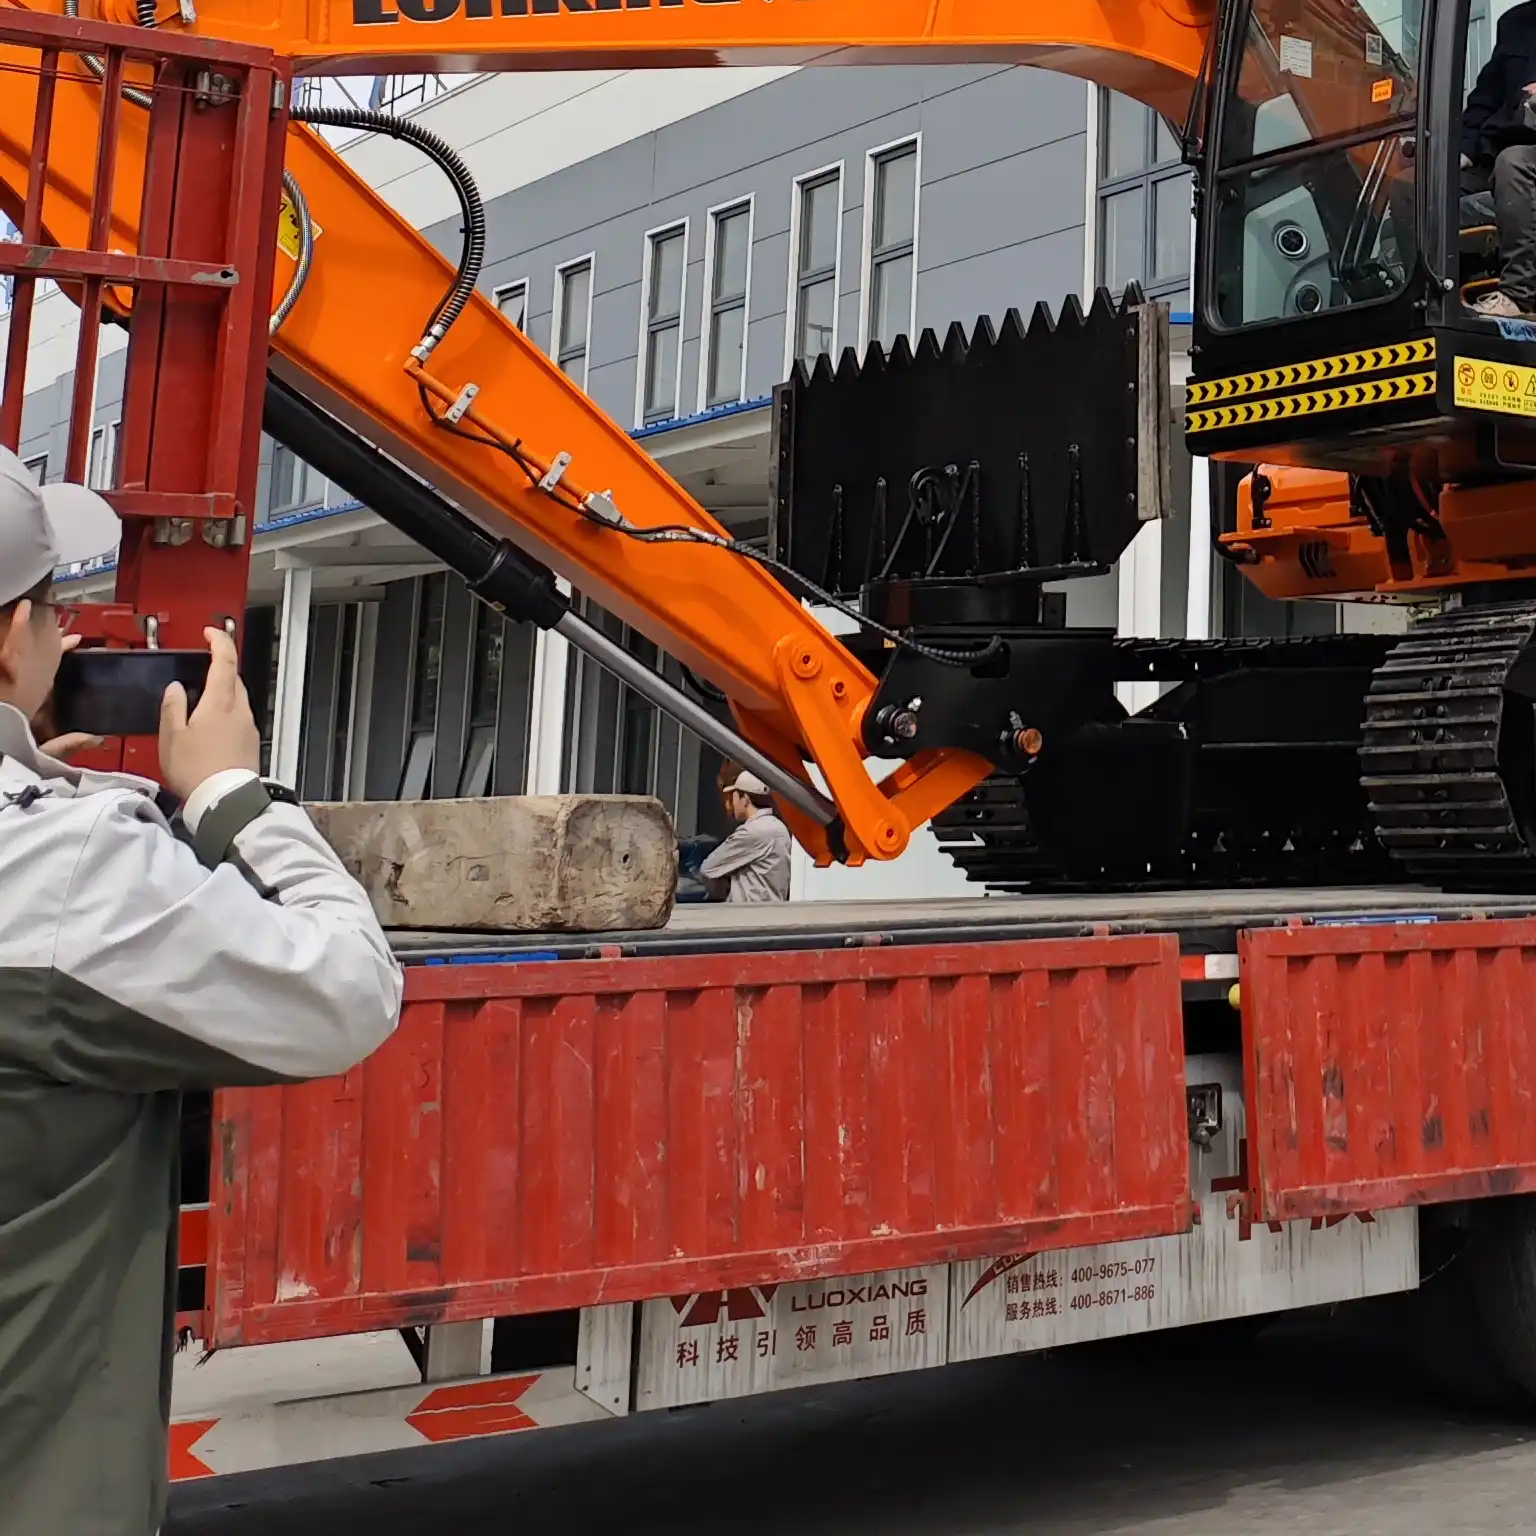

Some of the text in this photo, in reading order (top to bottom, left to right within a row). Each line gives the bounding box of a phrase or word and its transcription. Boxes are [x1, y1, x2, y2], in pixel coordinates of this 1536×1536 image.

[1071, 1257, 1156, 1284] 400-9675-077
[791, 1279, 928, 1312] LUOXIANG
[1070, 1284, 1156, 1311] 400-8671-886
[676, 1308, 928, 1369] 科技引领高品质
